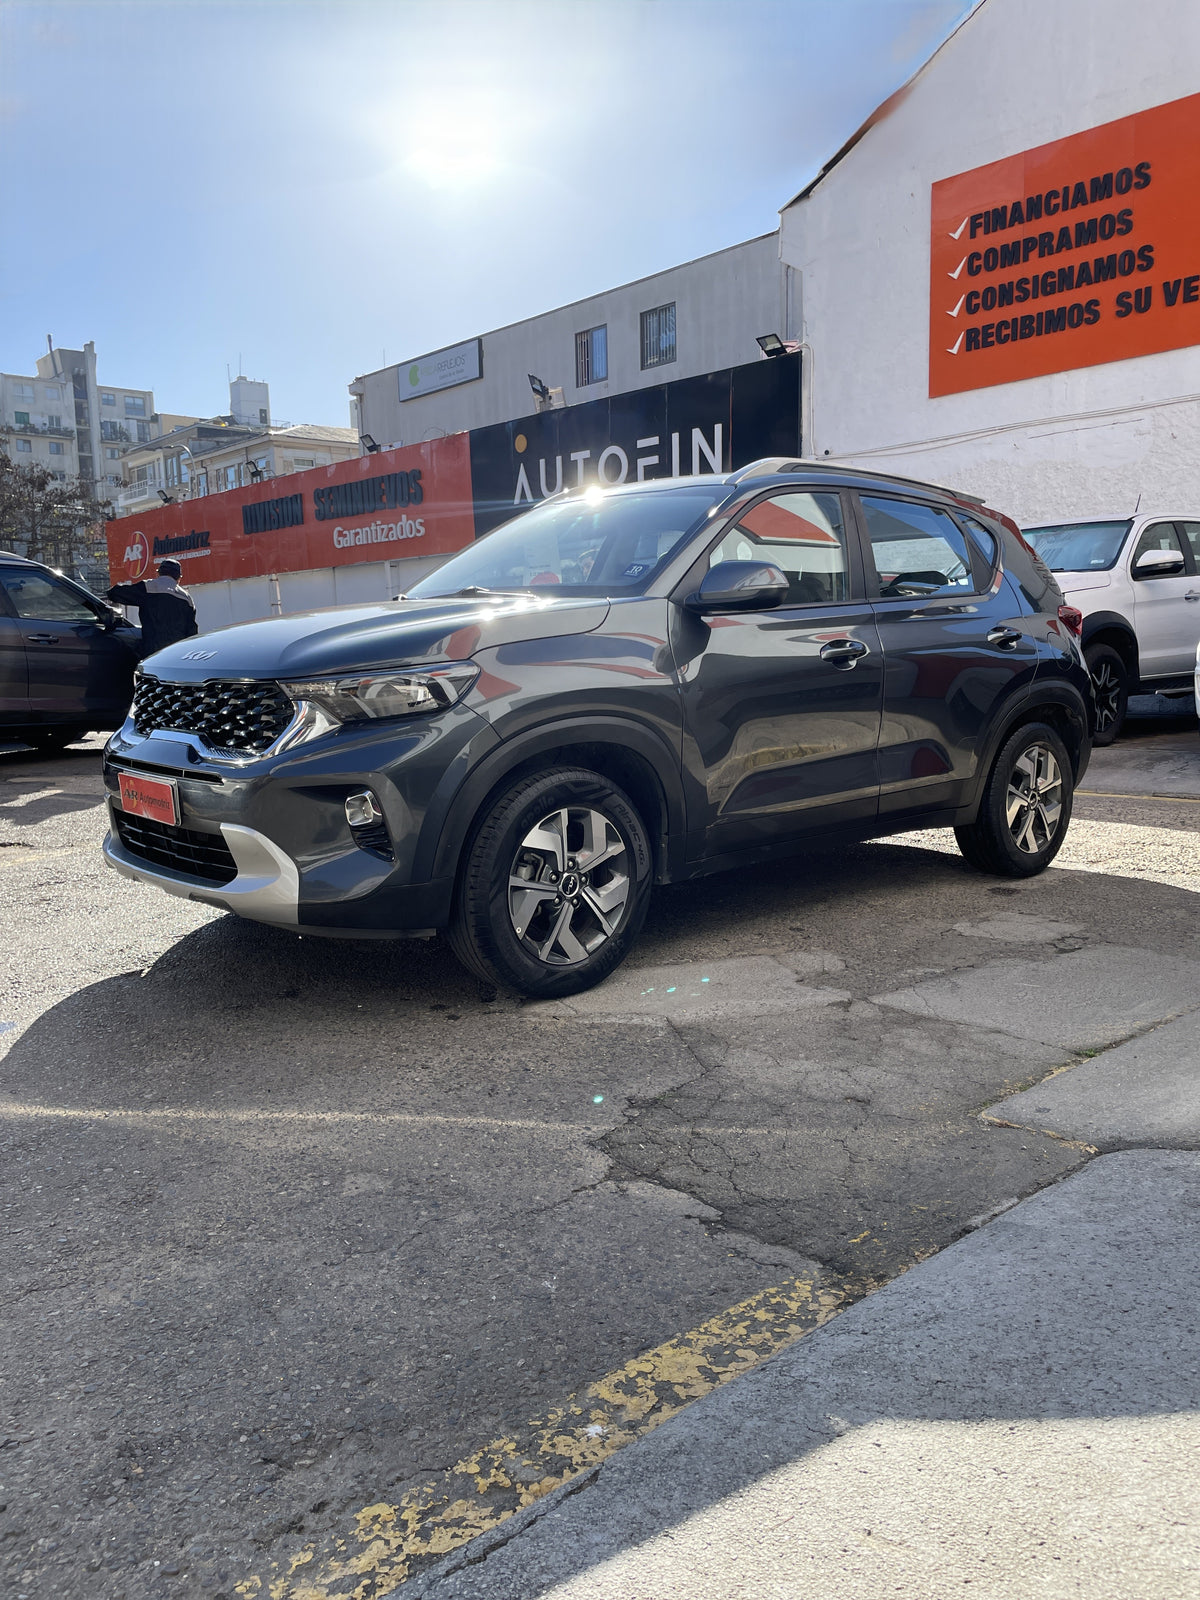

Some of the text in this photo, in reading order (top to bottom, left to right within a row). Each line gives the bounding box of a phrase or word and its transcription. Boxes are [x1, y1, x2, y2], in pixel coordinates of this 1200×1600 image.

[969, 161, 1152, 239] FINANCIAMOS
[966, 208, 1134, 277] COMPRAMOS
[965, 244, 1155, 316] CONSIGNAMOS
[965, 299, 1100, 352] RECIBIMOS
[1115, 285, 1152, 318] SU
[513, 423, 723, 505] AUTOFIN
[242, 469, 424, 535] DIVISION SEMINUEVOS
[333, 514, 426, 549] Garantizados
[123, 543, 143, 563] AR
[124, 788, 138, 801] AR
